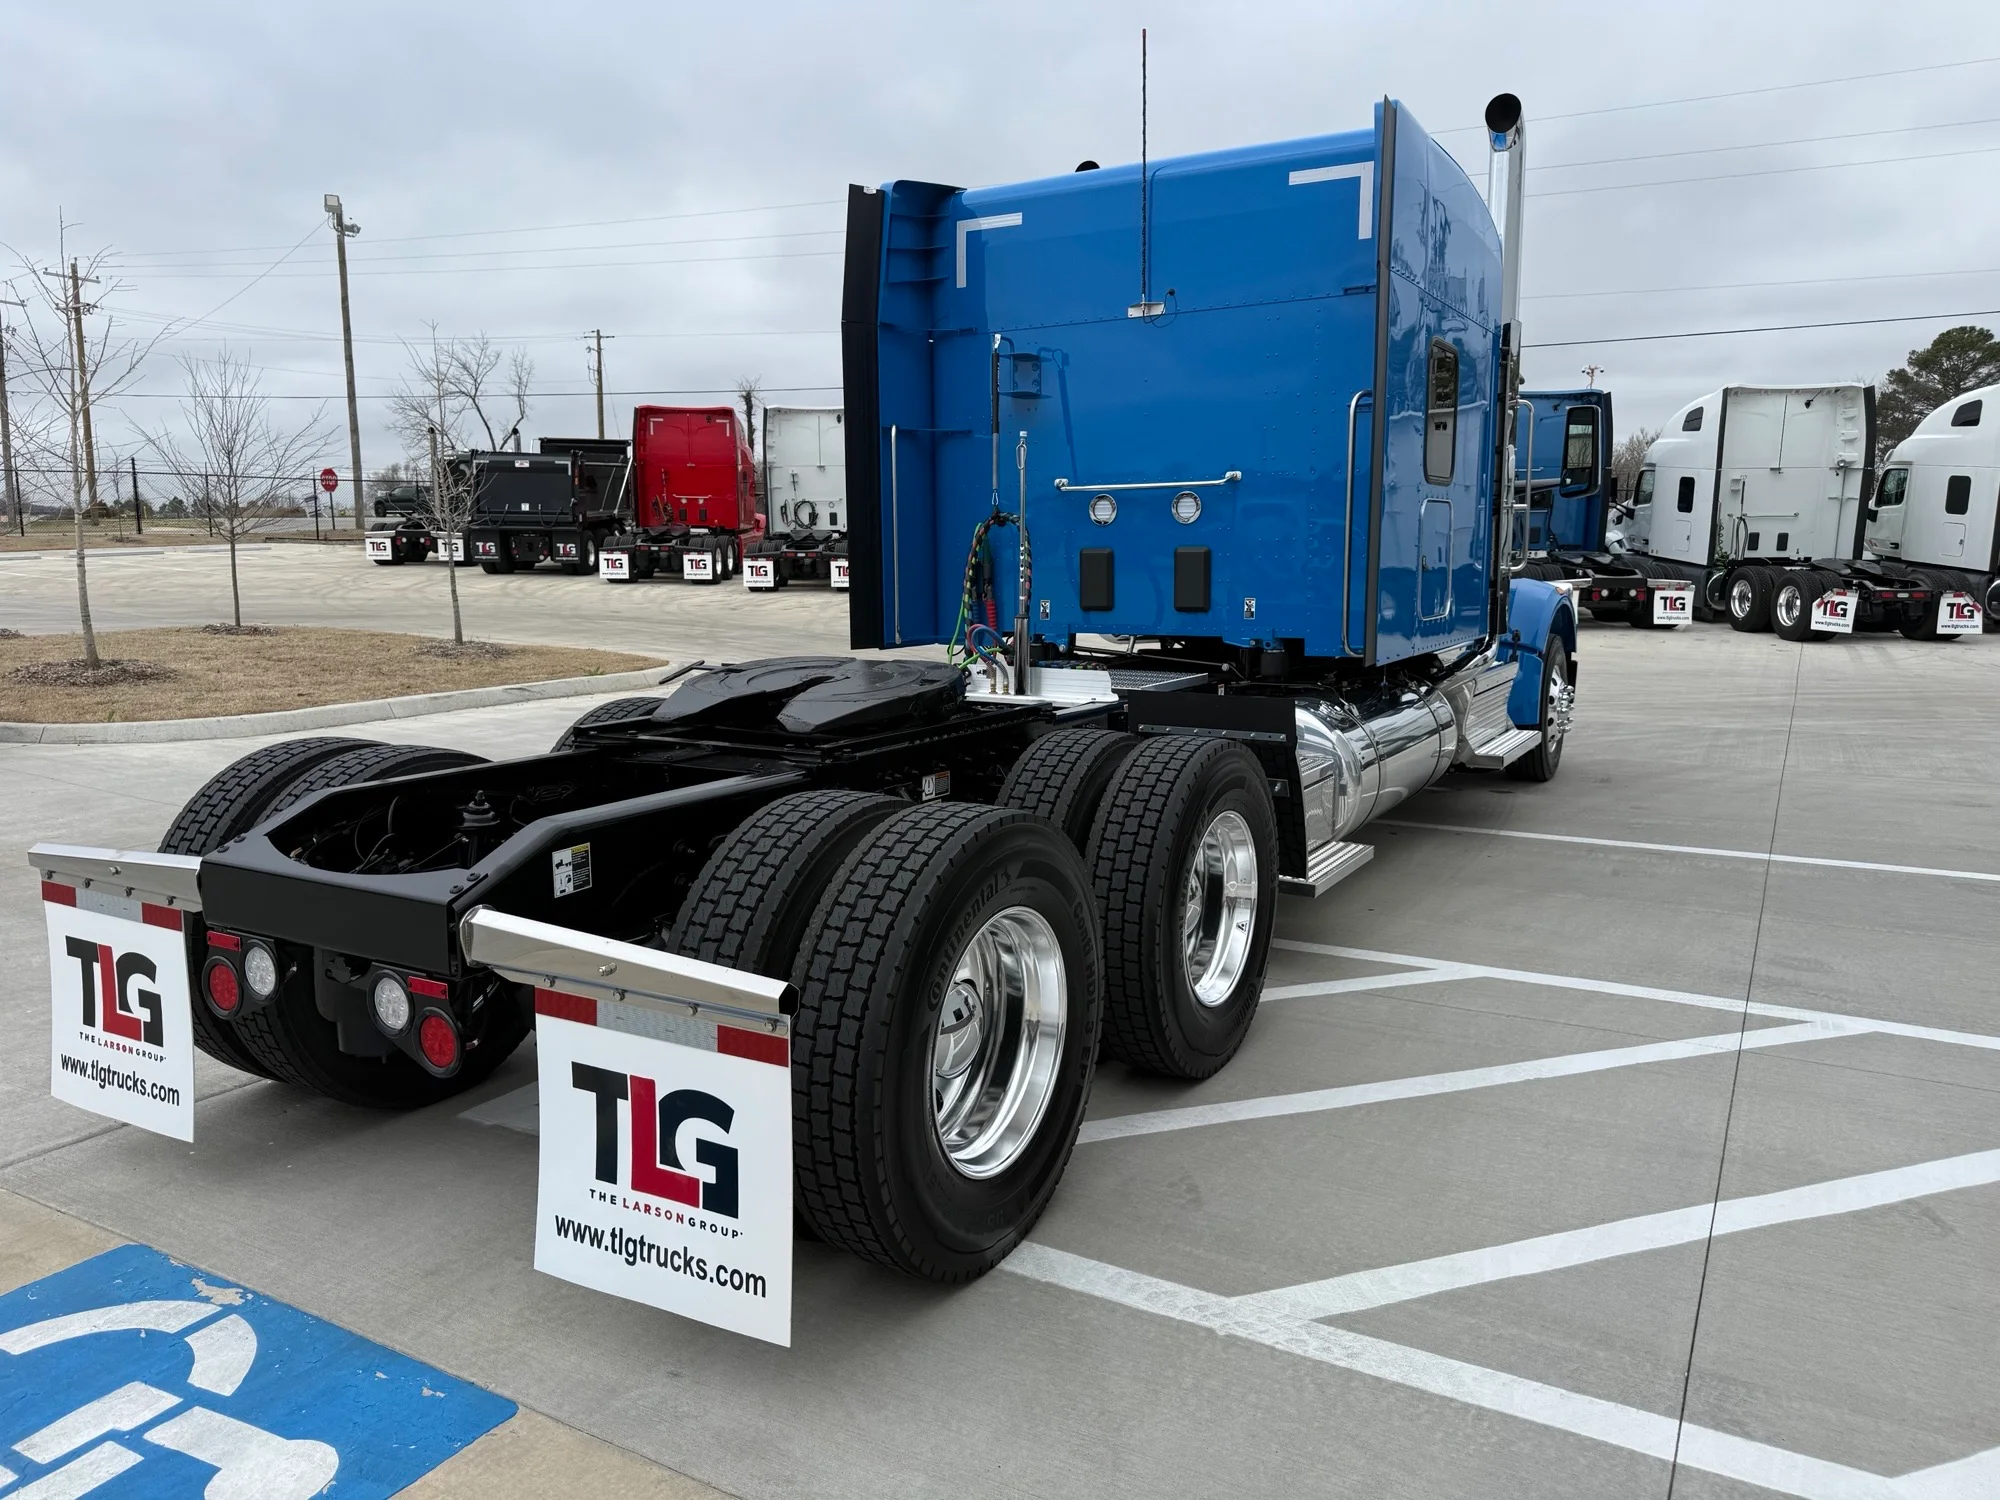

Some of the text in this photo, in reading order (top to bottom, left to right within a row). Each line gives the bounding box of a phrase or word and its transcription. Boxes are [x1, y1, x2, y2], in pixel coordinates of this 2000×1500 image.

[321, 475, 337, 486] STOP
[369, 541, 387, 552] TLG
[441, 542, 459, 552] TG
[475, 541, 496, 555] TLG
[556, 543, 576, 556] TLG
[603, 558, 624, 569] TLG
[687, 558, 708, 570] TLG
[747, 565, 769, 577] TLG
[835, 565, 849, 577] TL
[1659, 596, 1686, 612] TLG
[1822, 599, 1849, 618] TLG
[1946, 602, 1975, 619] TLG
[1073, 901, 1094, 958] Conti
[927, 871, 999, 1012] Continental
[65, 935, 164, 1048] TLG
[79, 1031, 165, 1063] THE LARSON GROUP
[60, 1053, 180, 1106] www.tlgtrucks.com
[571, 1060, 739, 1219] TLG
[589, 1188, 739, 1239] THE LARSON GROUP
[554, 1214, 767, 1298] www.tlgtrucks.com
